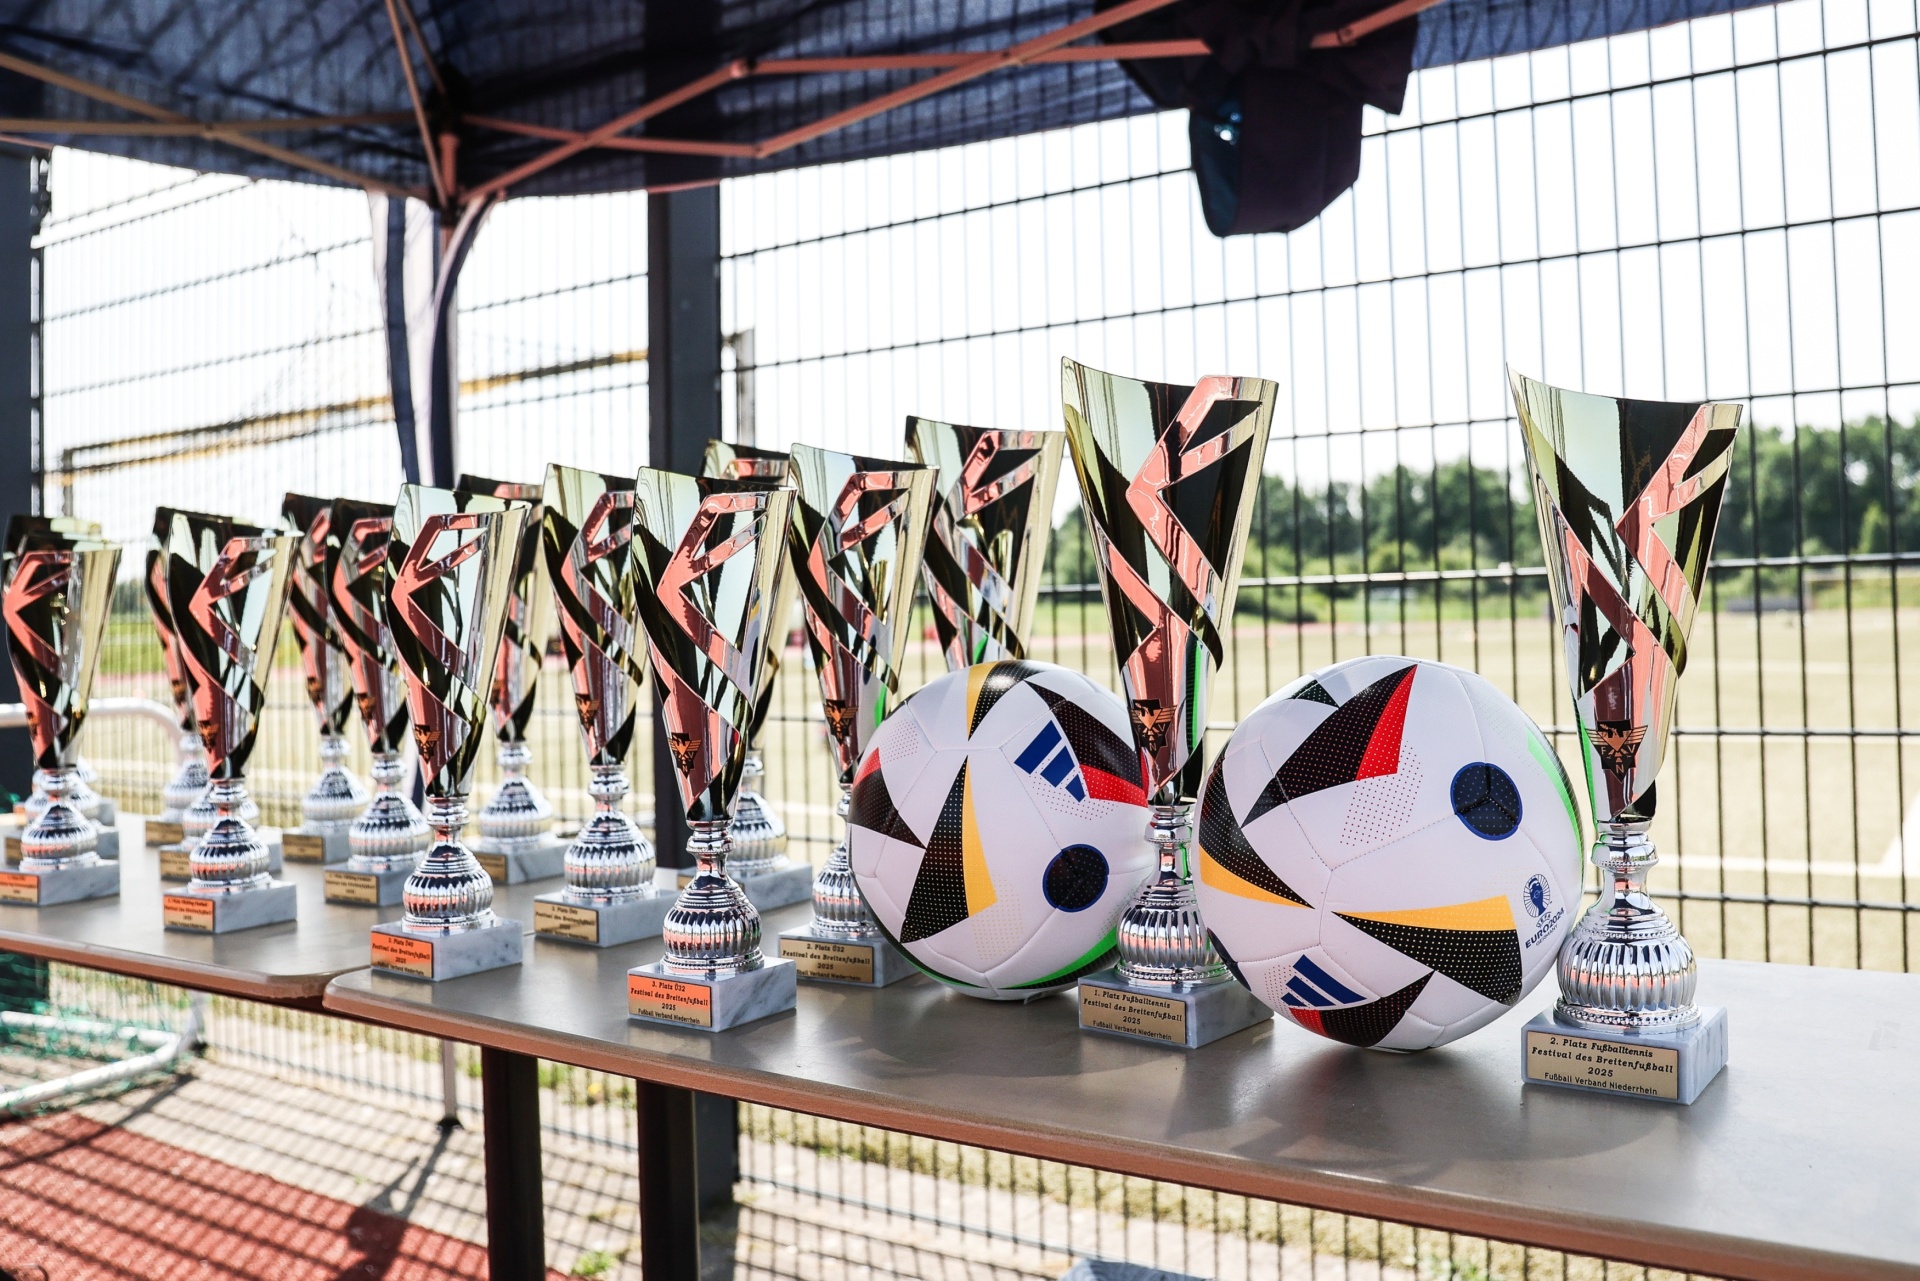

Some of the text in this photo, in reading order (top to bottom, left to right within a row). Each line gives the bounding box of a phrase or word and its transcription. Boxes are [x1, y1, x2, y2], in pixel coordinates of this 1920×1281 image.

[782, 950, 808, 958] Festival
[823, 954, 870, 964] Breitenfußball
[630, 988, 653, 997] Festival
[666, 993, 708, 1006] Breitenfußball
[1102, 991, 1120, 1000] Platz
[1122, 995, 1170, 1008] Fußballtennis
[1083, 998, 1182, 1021] Festival des Breitenfußball
[1123, 1016, 1140, 1024] 2025
[1093, 1020, 1172, 1040] Fußball Verband Niederrhein
[1550, 1037, 1653, 1058] 2. Platz Fußballtennis
[1531, 1046, 1673, 1074] Festival des Breitenfußball
[1588, 1067, 1613, 1077] 2025
[1544, 1072, 1658, 1095] Fußball Verband Niederrhein
